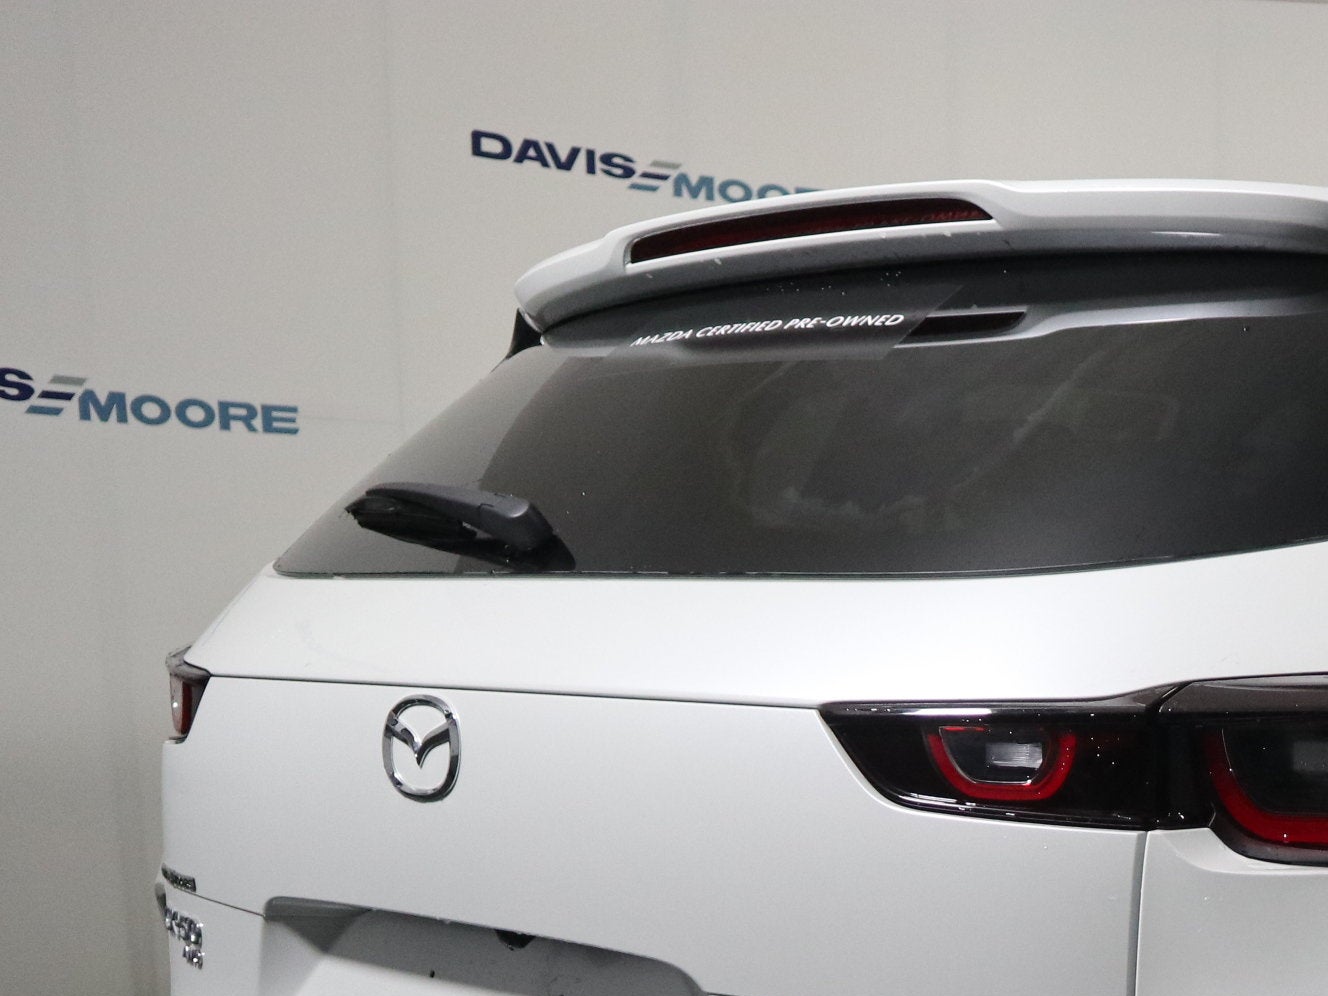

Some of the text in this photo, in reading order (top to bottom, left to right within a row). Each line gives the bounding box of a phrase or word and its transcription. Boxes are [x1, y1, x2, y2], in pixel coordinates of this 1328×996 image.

[471, 129, 636, 180] DAVIS
[630, 313, 904, 347] MAZDA CERTIFIED PRE-OWNED
[77, 388, 300, 436] MOORE
